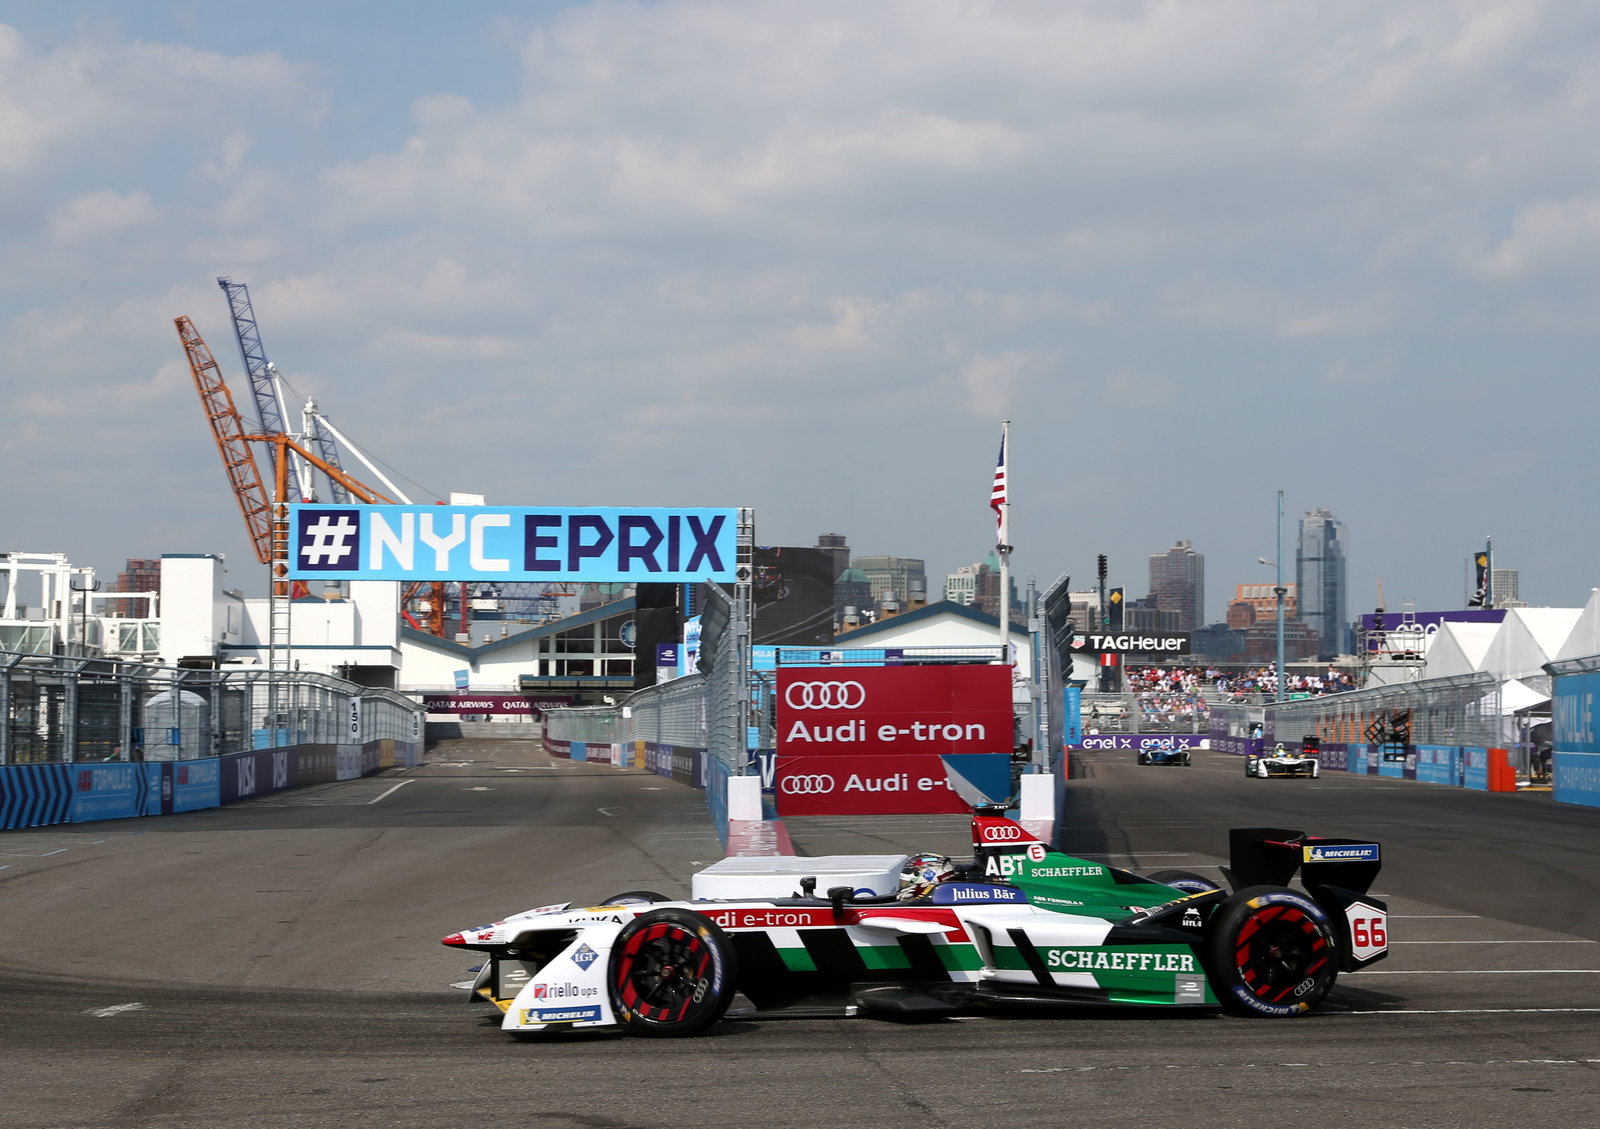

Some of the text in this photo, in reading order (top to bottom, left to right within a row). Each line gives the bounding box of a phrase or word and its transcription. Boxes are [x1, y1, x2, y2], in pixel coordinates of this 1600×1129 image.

[524, 515, 725, 572] EPRIX
[428, 701, 494, 709] QATAR AIRWAYS
[502, 701, 568, 709] QATAR AIRWAYS
[786, 720, 985, 743] Audi e-tron
[1082, 736, 1117, 749] enel
[237, 756, 256, 796] VISA
[843, 773, 908, 791] Audi
[985, 855, 1026, 876] ABT
[1031, 866, 1103, 877] SCHAEFFLER
[952, 888, 1016, 901] Julius Bär
[743, 912, 811, 925] e-tron
[1353, 918, 1386, 947] 66
[575, 953, 595, 962] LGT
[1048, 949, 1194, 972] SCHAEFFLER
[549, 982, 598, 998] riello ups
[541, 1010, 596, 1019] MICHELIN
